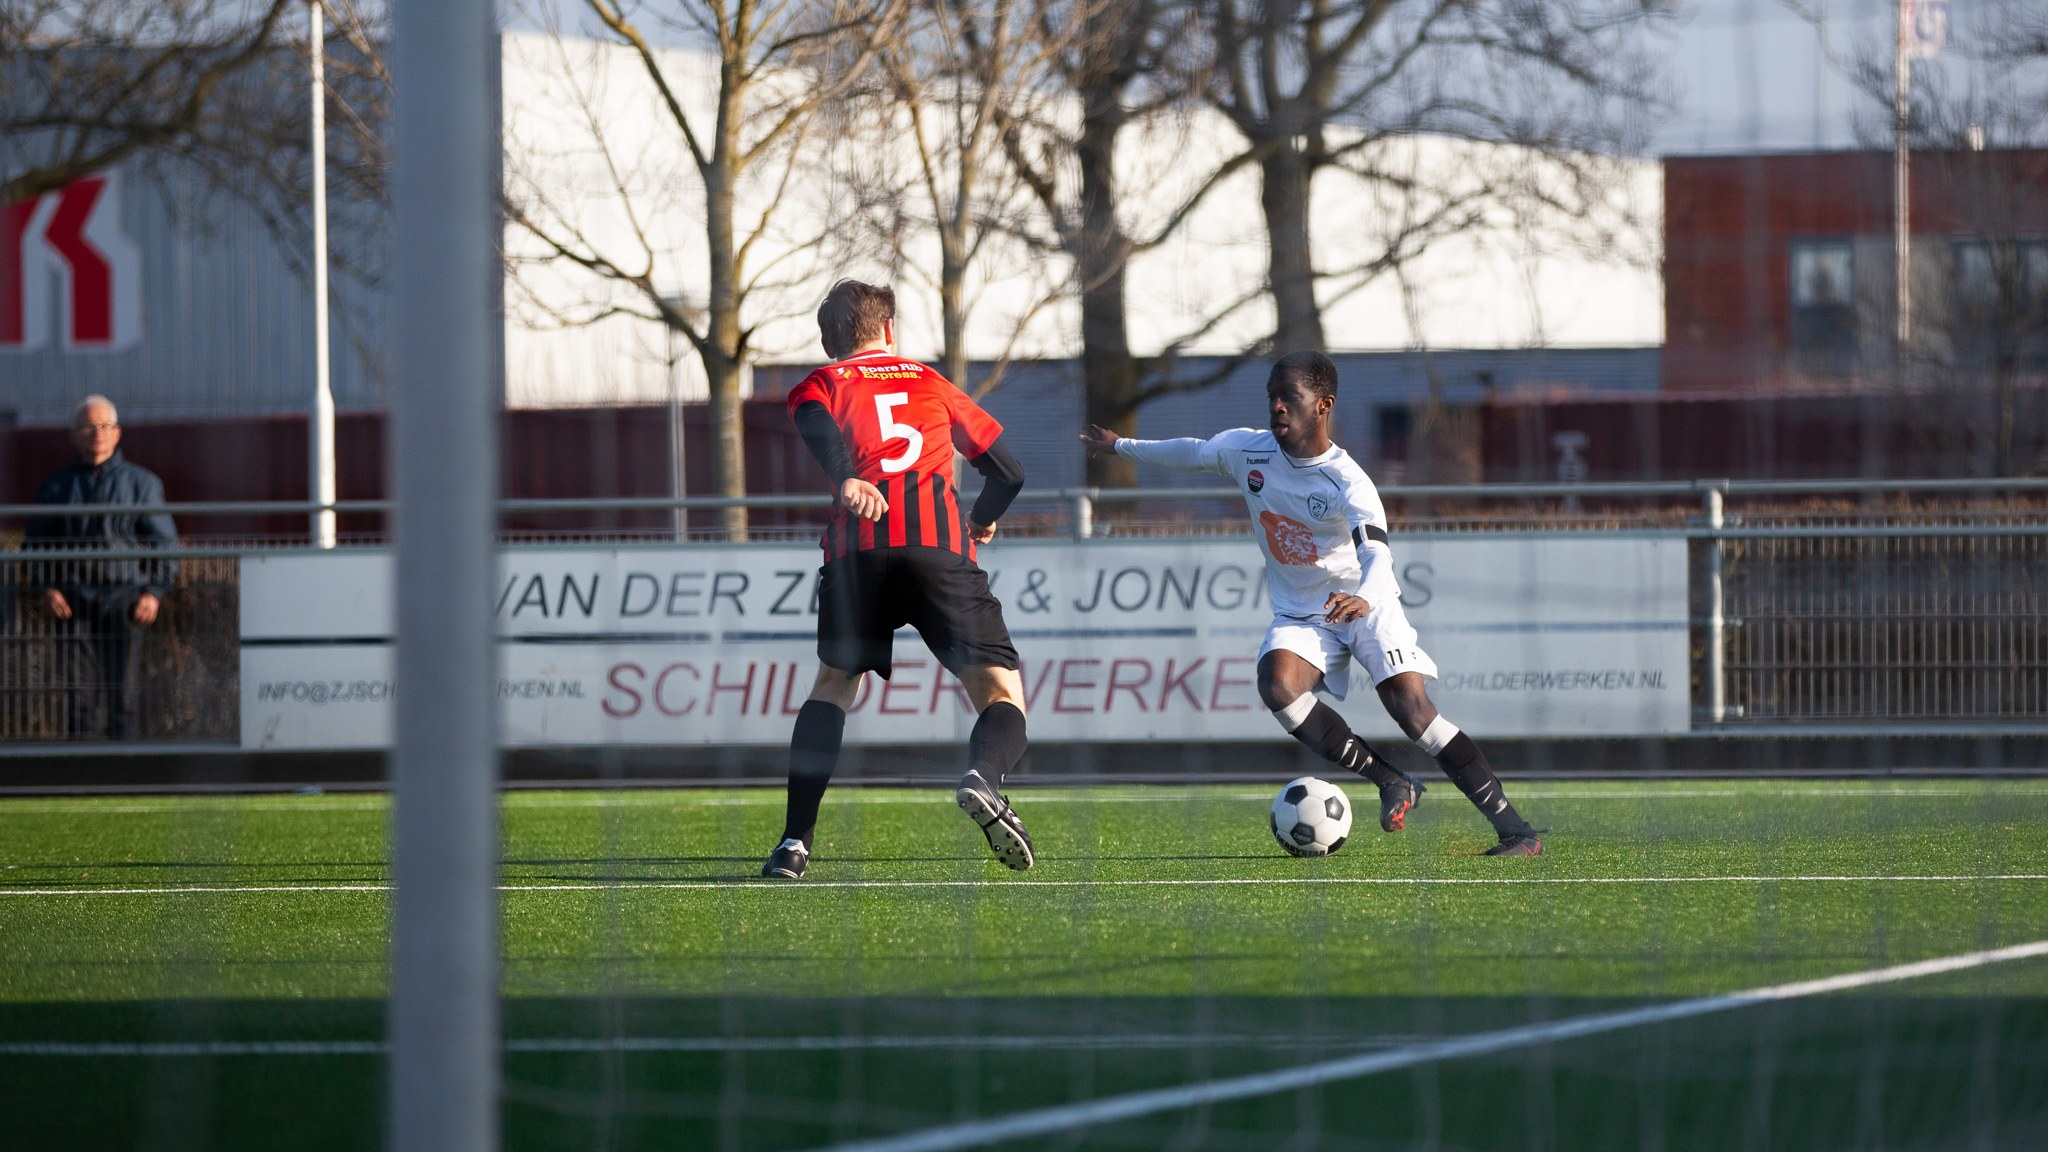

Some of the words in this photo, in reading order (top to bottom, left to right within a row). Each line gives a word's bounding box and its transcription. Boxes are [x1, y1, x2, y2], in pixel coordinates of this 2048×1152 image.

[857, 365, 899, 373] Spare
[899, 363, 924, 372] Rib
[862, 371, 922, 380] Express.
[873, 391, 924, 473] 5
[1246, 457, 1270, 465] hummel
[619, 572, 751, 617] DER
[1016, 567, 1052, 613] &
[1073, 562, 1435, 614] JONGS
[1387, 648, 1404, 666] 11
